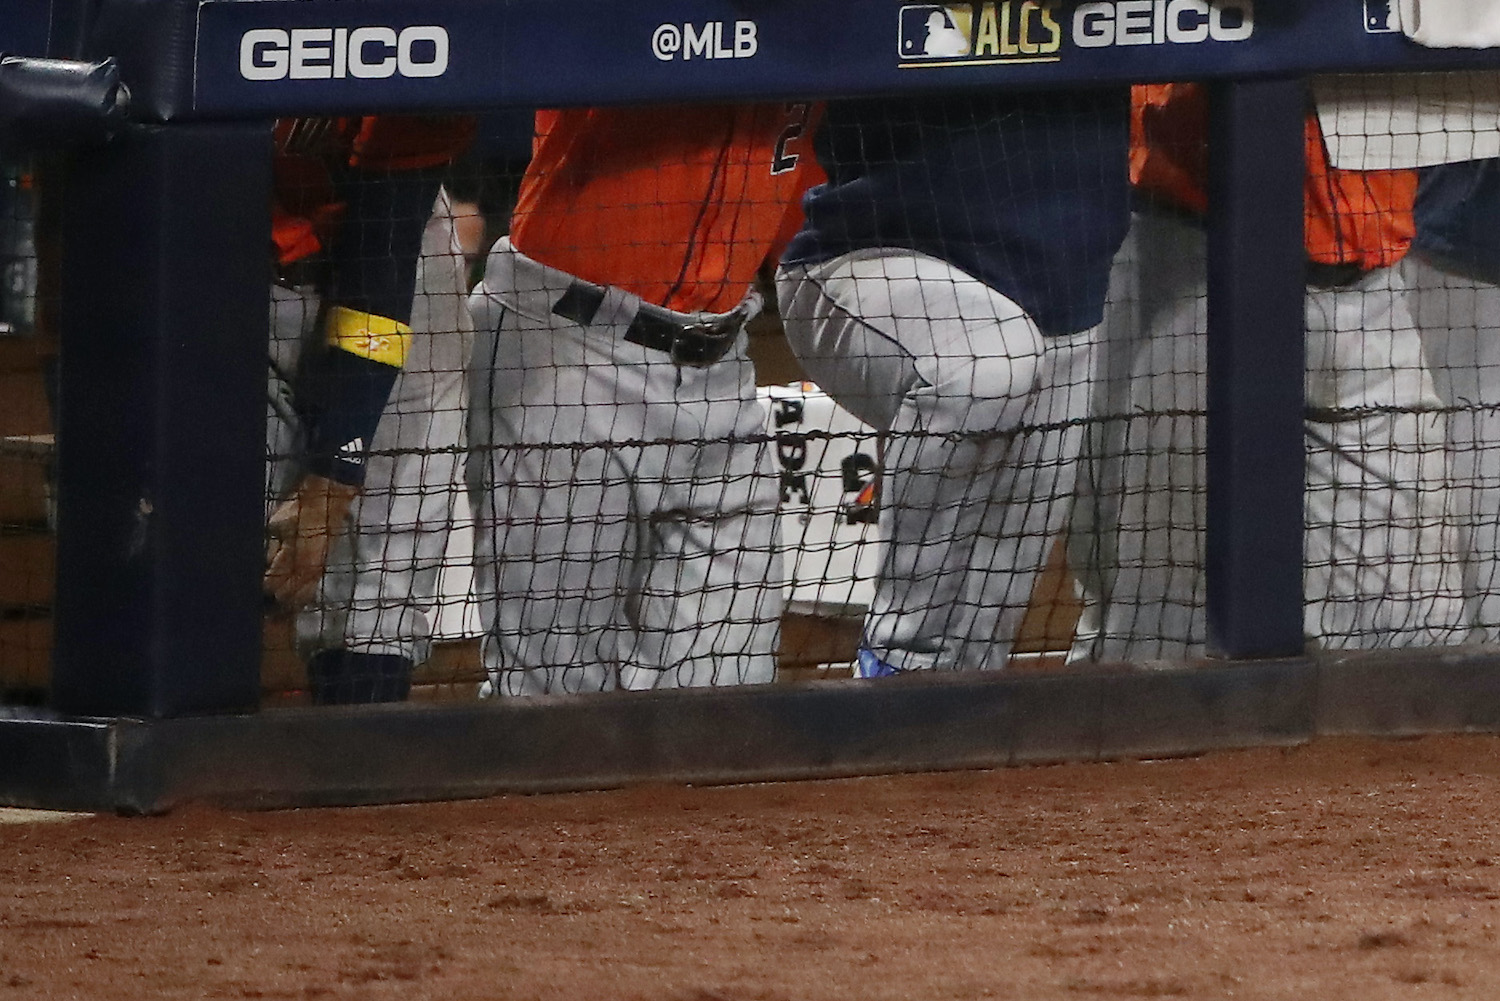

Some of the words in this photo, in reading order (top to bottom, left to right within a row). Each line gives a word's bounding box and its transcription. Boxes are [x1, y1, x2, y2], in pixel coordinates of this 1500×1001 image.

[239, 25, 449, 81] GEICO
[651, 20, 758, 62] @MLB
[974, 0, 1062, 57] ALCS
